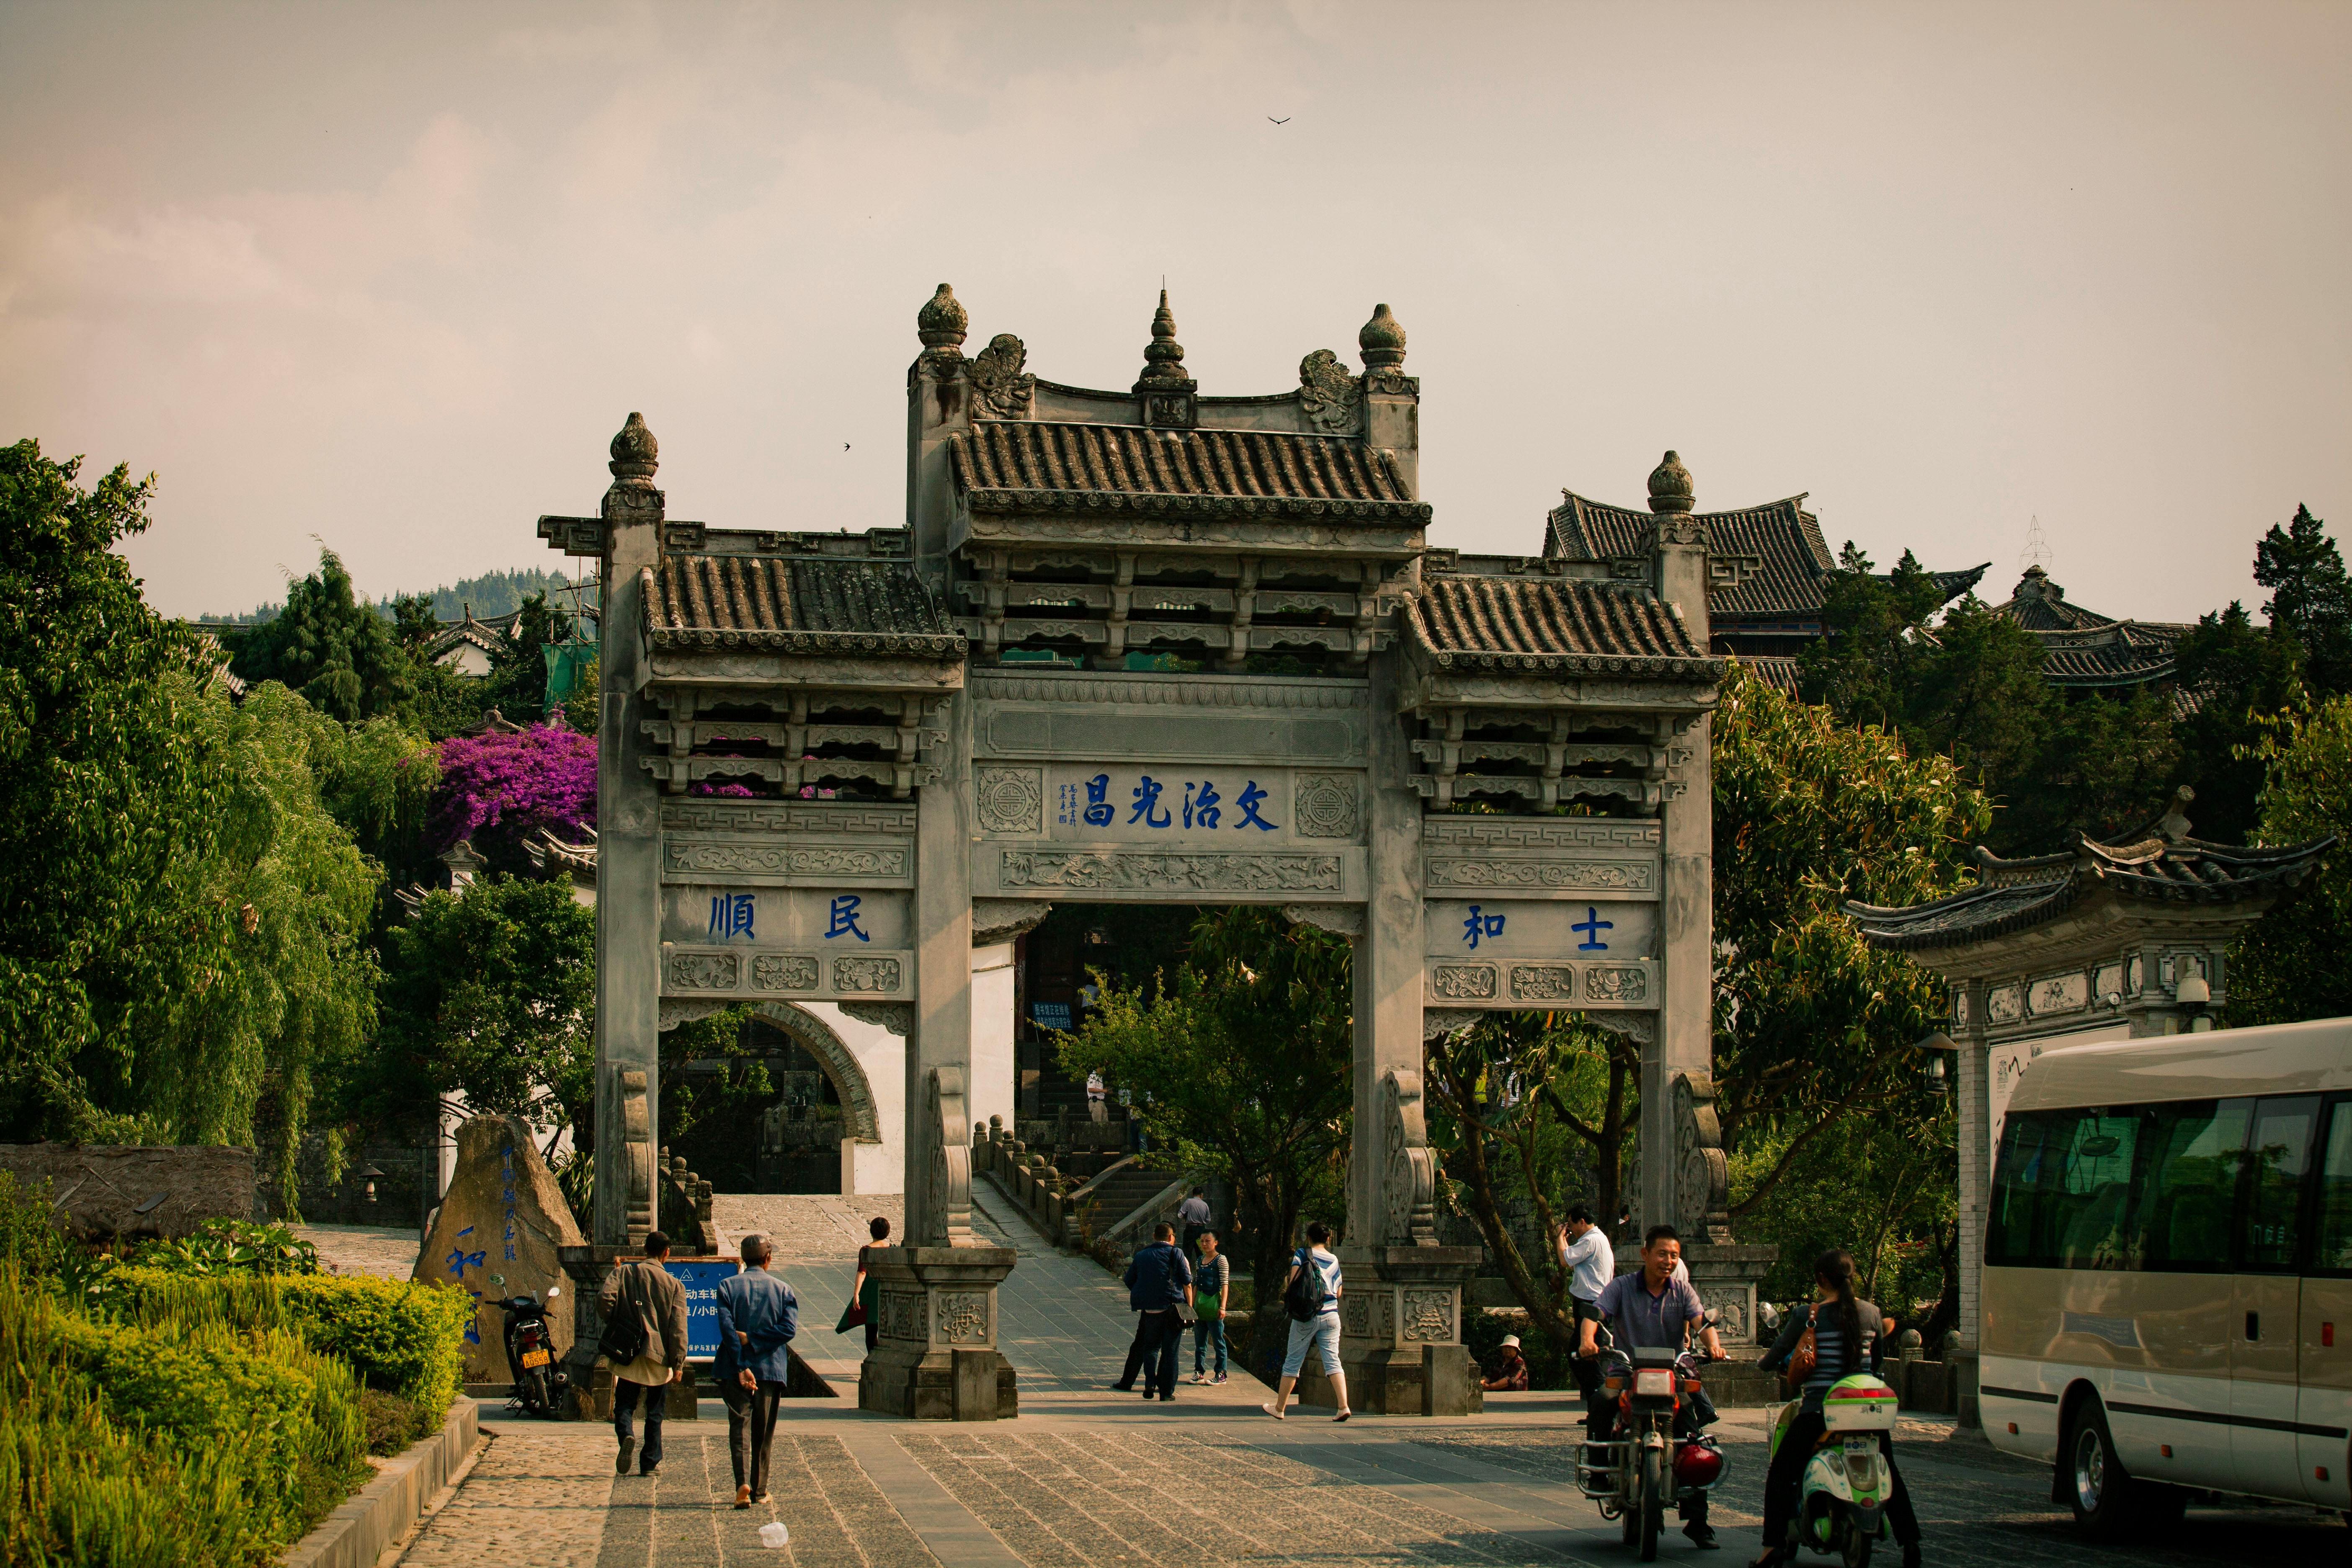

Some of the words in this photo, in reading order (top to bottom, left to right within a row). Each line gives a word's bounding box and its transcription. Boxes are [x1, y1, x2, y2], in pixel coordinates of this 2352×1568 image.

[1083, 774, 1279, 831] 文治光昌
[1035, 1004, 1069, 1015] 图书馆正在维修
[526, 1357, 548, 1367] AQ558
